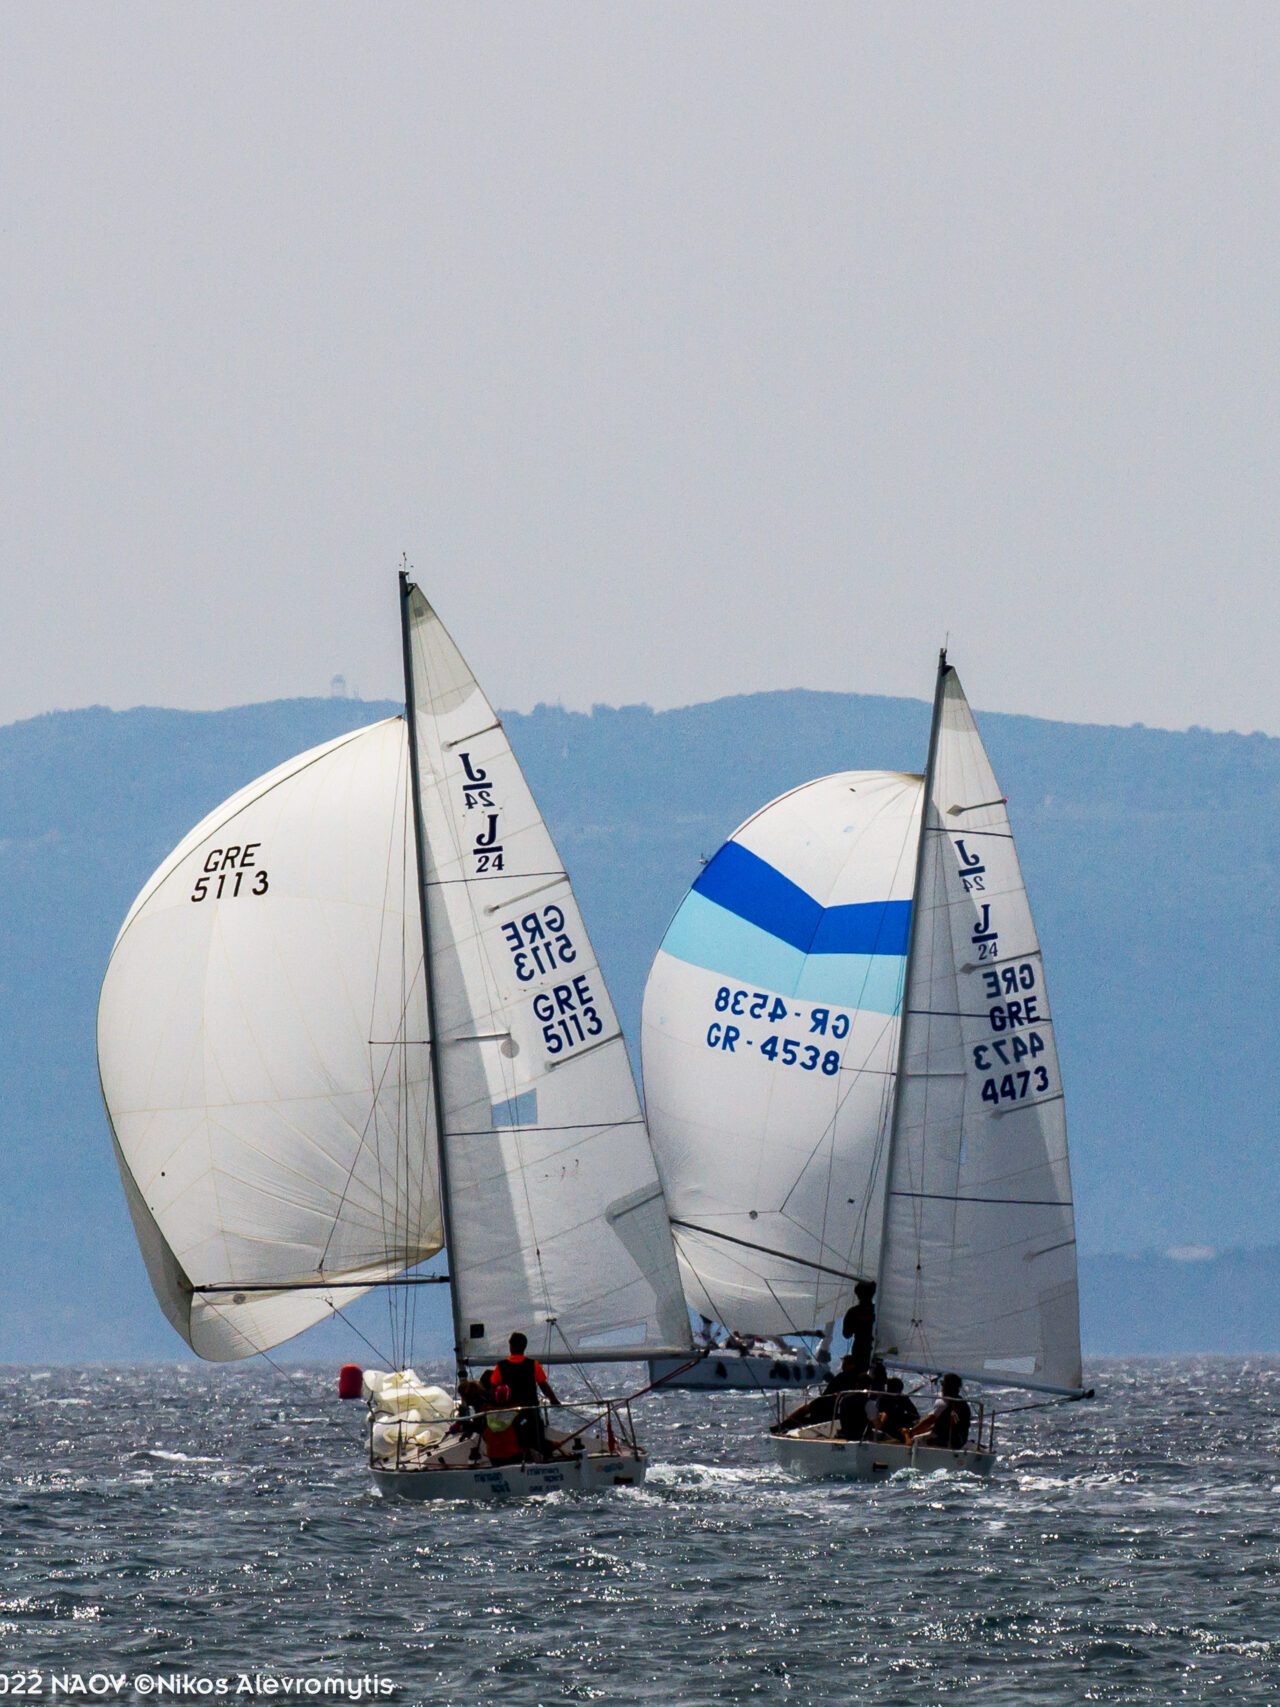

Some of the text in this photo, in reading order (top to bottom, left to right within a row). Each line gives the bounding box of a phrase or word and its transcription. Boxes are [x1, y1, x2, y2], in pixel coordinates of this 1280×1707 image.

[476, 814, 499, 846] J
[203, 842, 261, 873] GRE
[475, 853, 504, 873] 24
[191, 870, 269, 902] 5113
[974, 904, 991, 934] J
[978, 942, 998, 961] 24
[533, 974, 594, 1022] GRE
[989, 995, 1041, 1032] GRE
[542, 1006, 603, 1054] 5113
[981, 1065, 1049, 1105] 4473
